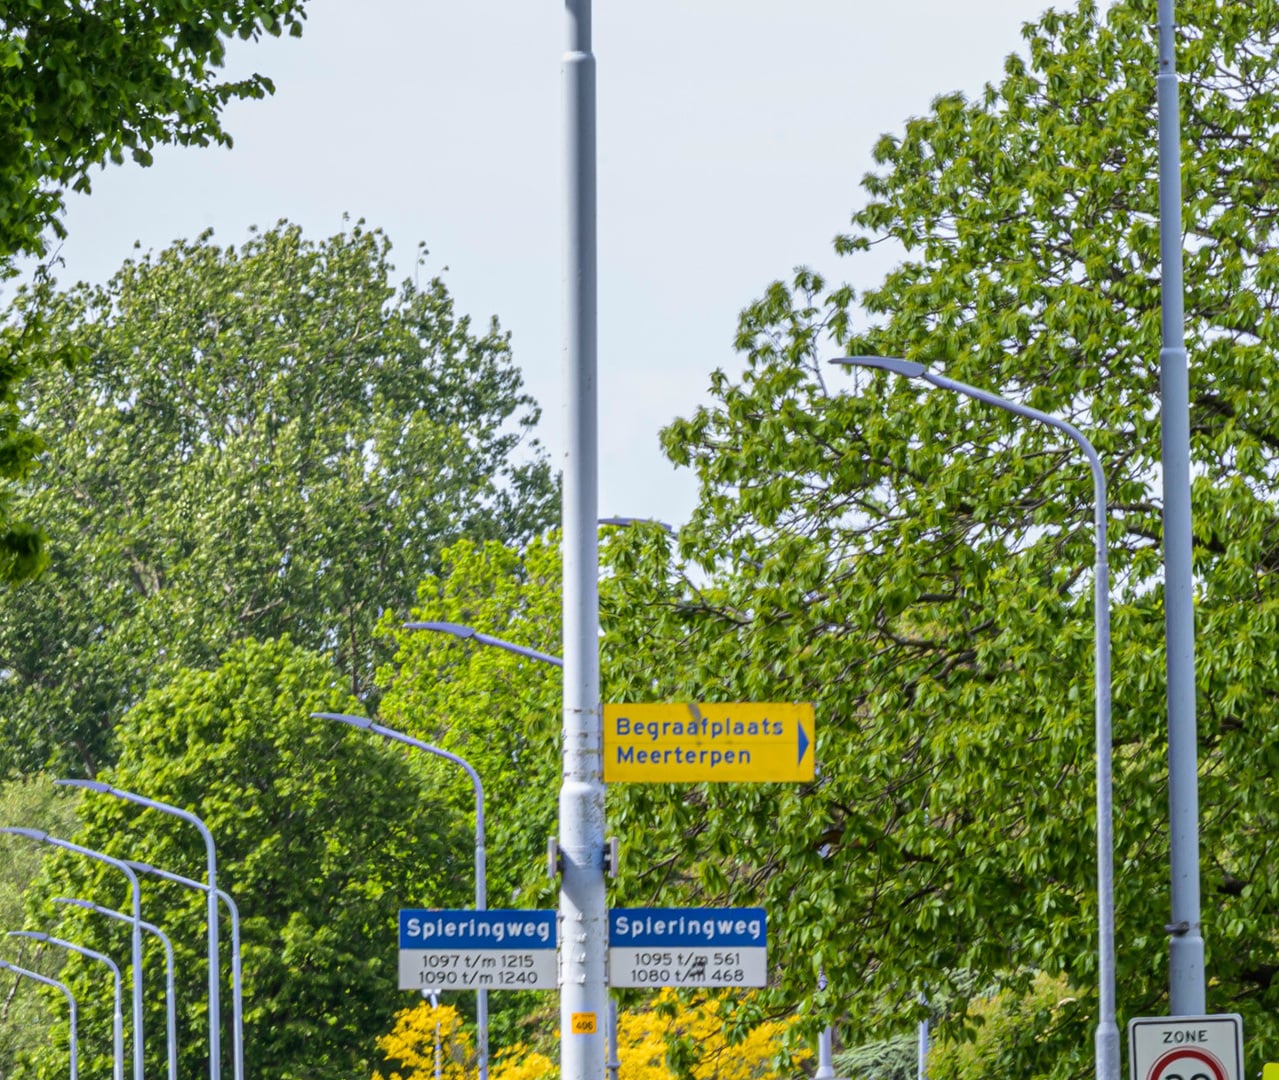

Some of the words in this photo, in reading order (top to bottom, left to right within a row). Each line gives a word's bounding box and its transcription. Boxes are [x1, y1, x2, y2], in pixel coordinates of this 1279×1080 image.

[616, 717, 783, 741] Begraafplaats
[616, 746, 751, 767] Meerterpen
[406, 918, 550, 942] Spieringweg
[615, 916, 761, 940] Spieringweg
[422, 954, 460, 967] 1097
[464, 954, 496, 968] t/m
[501, 954, 534, 967] 1215
[634, 953, 672, 966] 1095
[677, 952, 708, 967] t/m
[713, 953, 740, 966] 561
[419, 971, 457, 984] 1090
[462, 971, 494, 984] t/m
[498, 971, 538, 984] 1240
[631, 969, 670, 982] 1080
[674, 969, 706, 983] t/m
[711, 969, 744, 982] 468
[1162, 1030, 1208, 1044] ZONE
